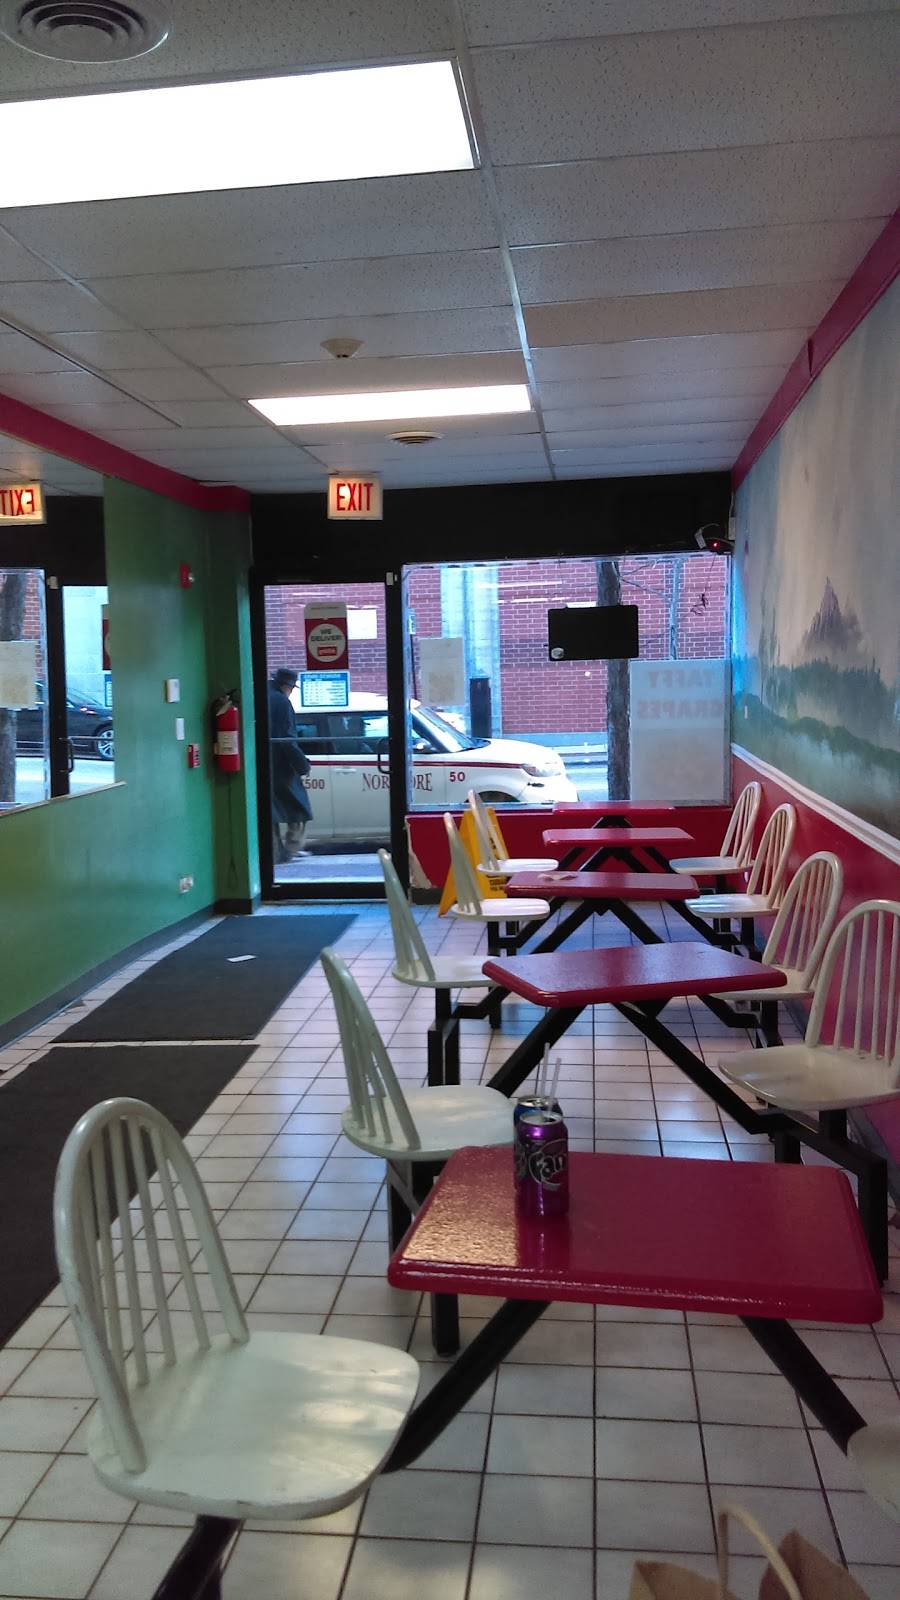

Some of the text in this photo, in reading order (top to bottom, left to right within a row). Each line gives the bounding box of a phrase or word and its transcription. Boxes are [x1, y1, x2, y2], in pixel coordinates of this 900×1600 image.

[336, 482, 374, 511] EXIT
[449, 771, 466, 783] 50
[302, 778, 325, 790] 500
